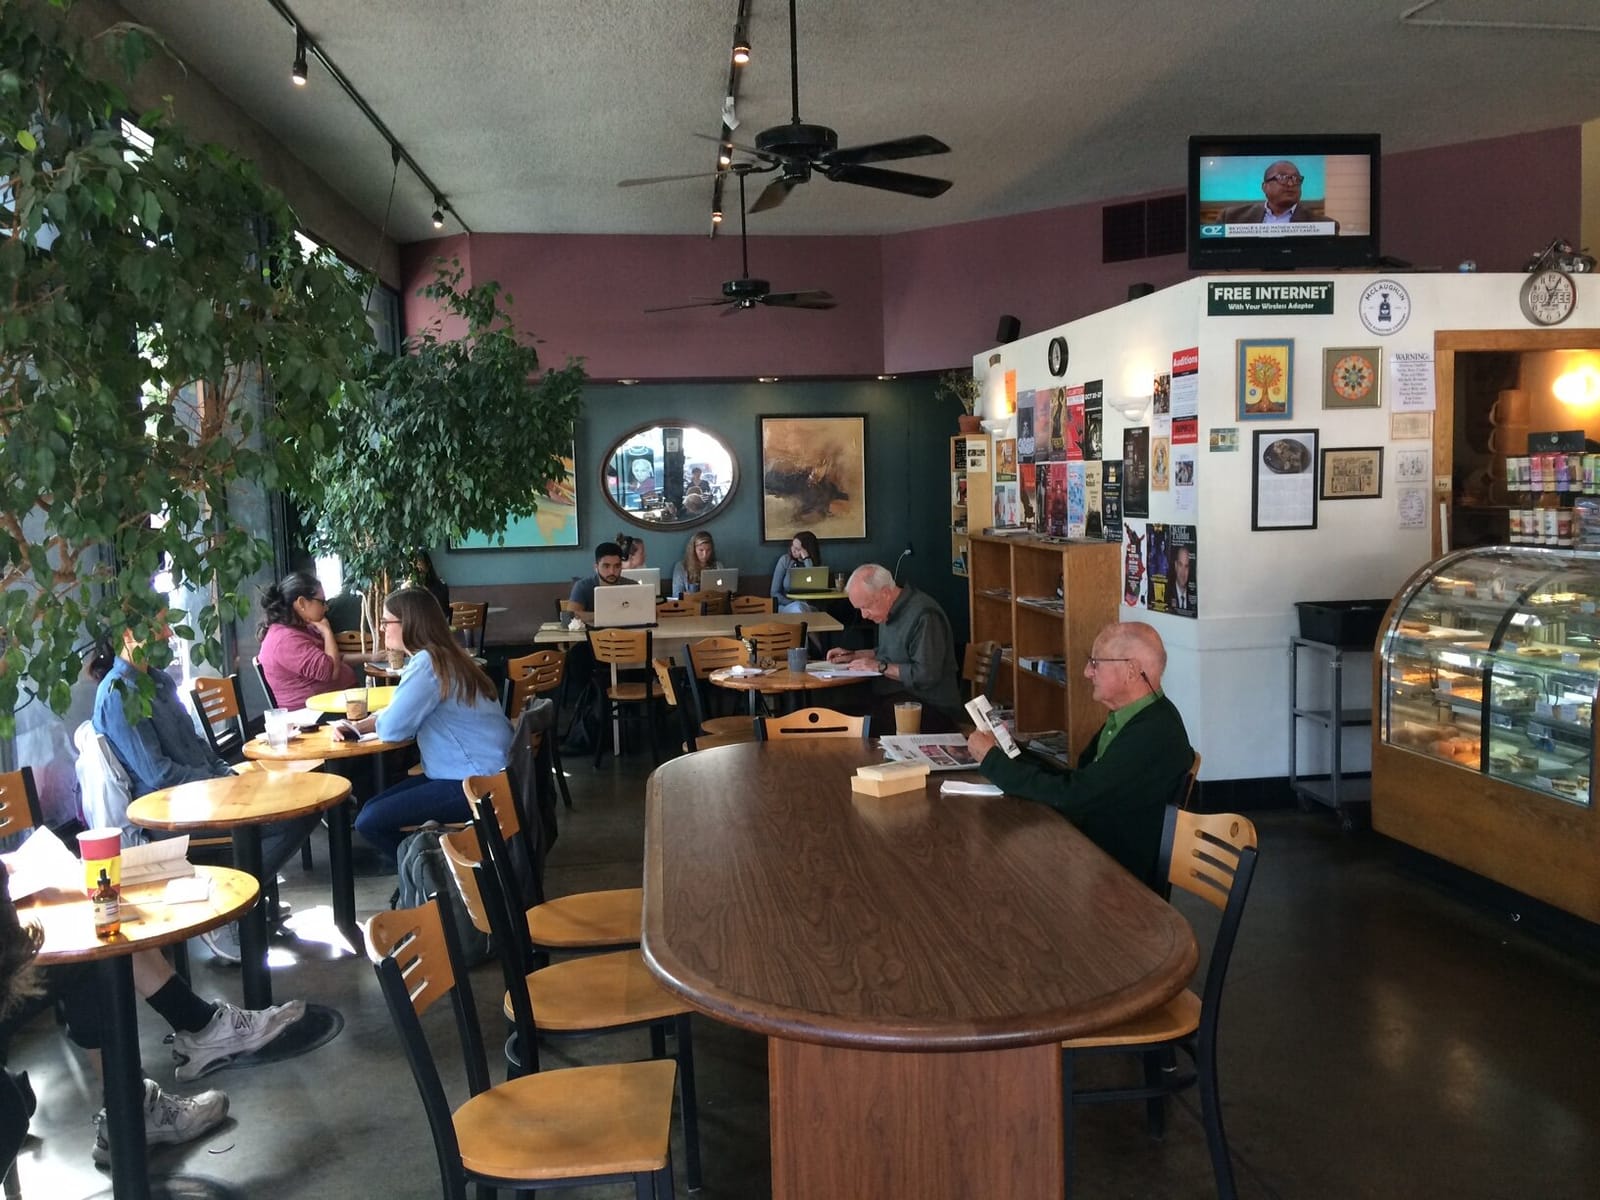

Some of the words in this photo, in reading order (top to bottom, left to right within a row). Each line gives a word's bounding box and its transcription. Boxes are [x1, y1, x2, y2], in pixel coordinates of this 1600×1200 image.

[1214, 287, 1252, 301] FREE
[1255, 286, 1328, 300] INTERNET
[1365, 284, 1405, 301] MCLAUGHLIN
[1287, 302, 1314, 310] Adapter
